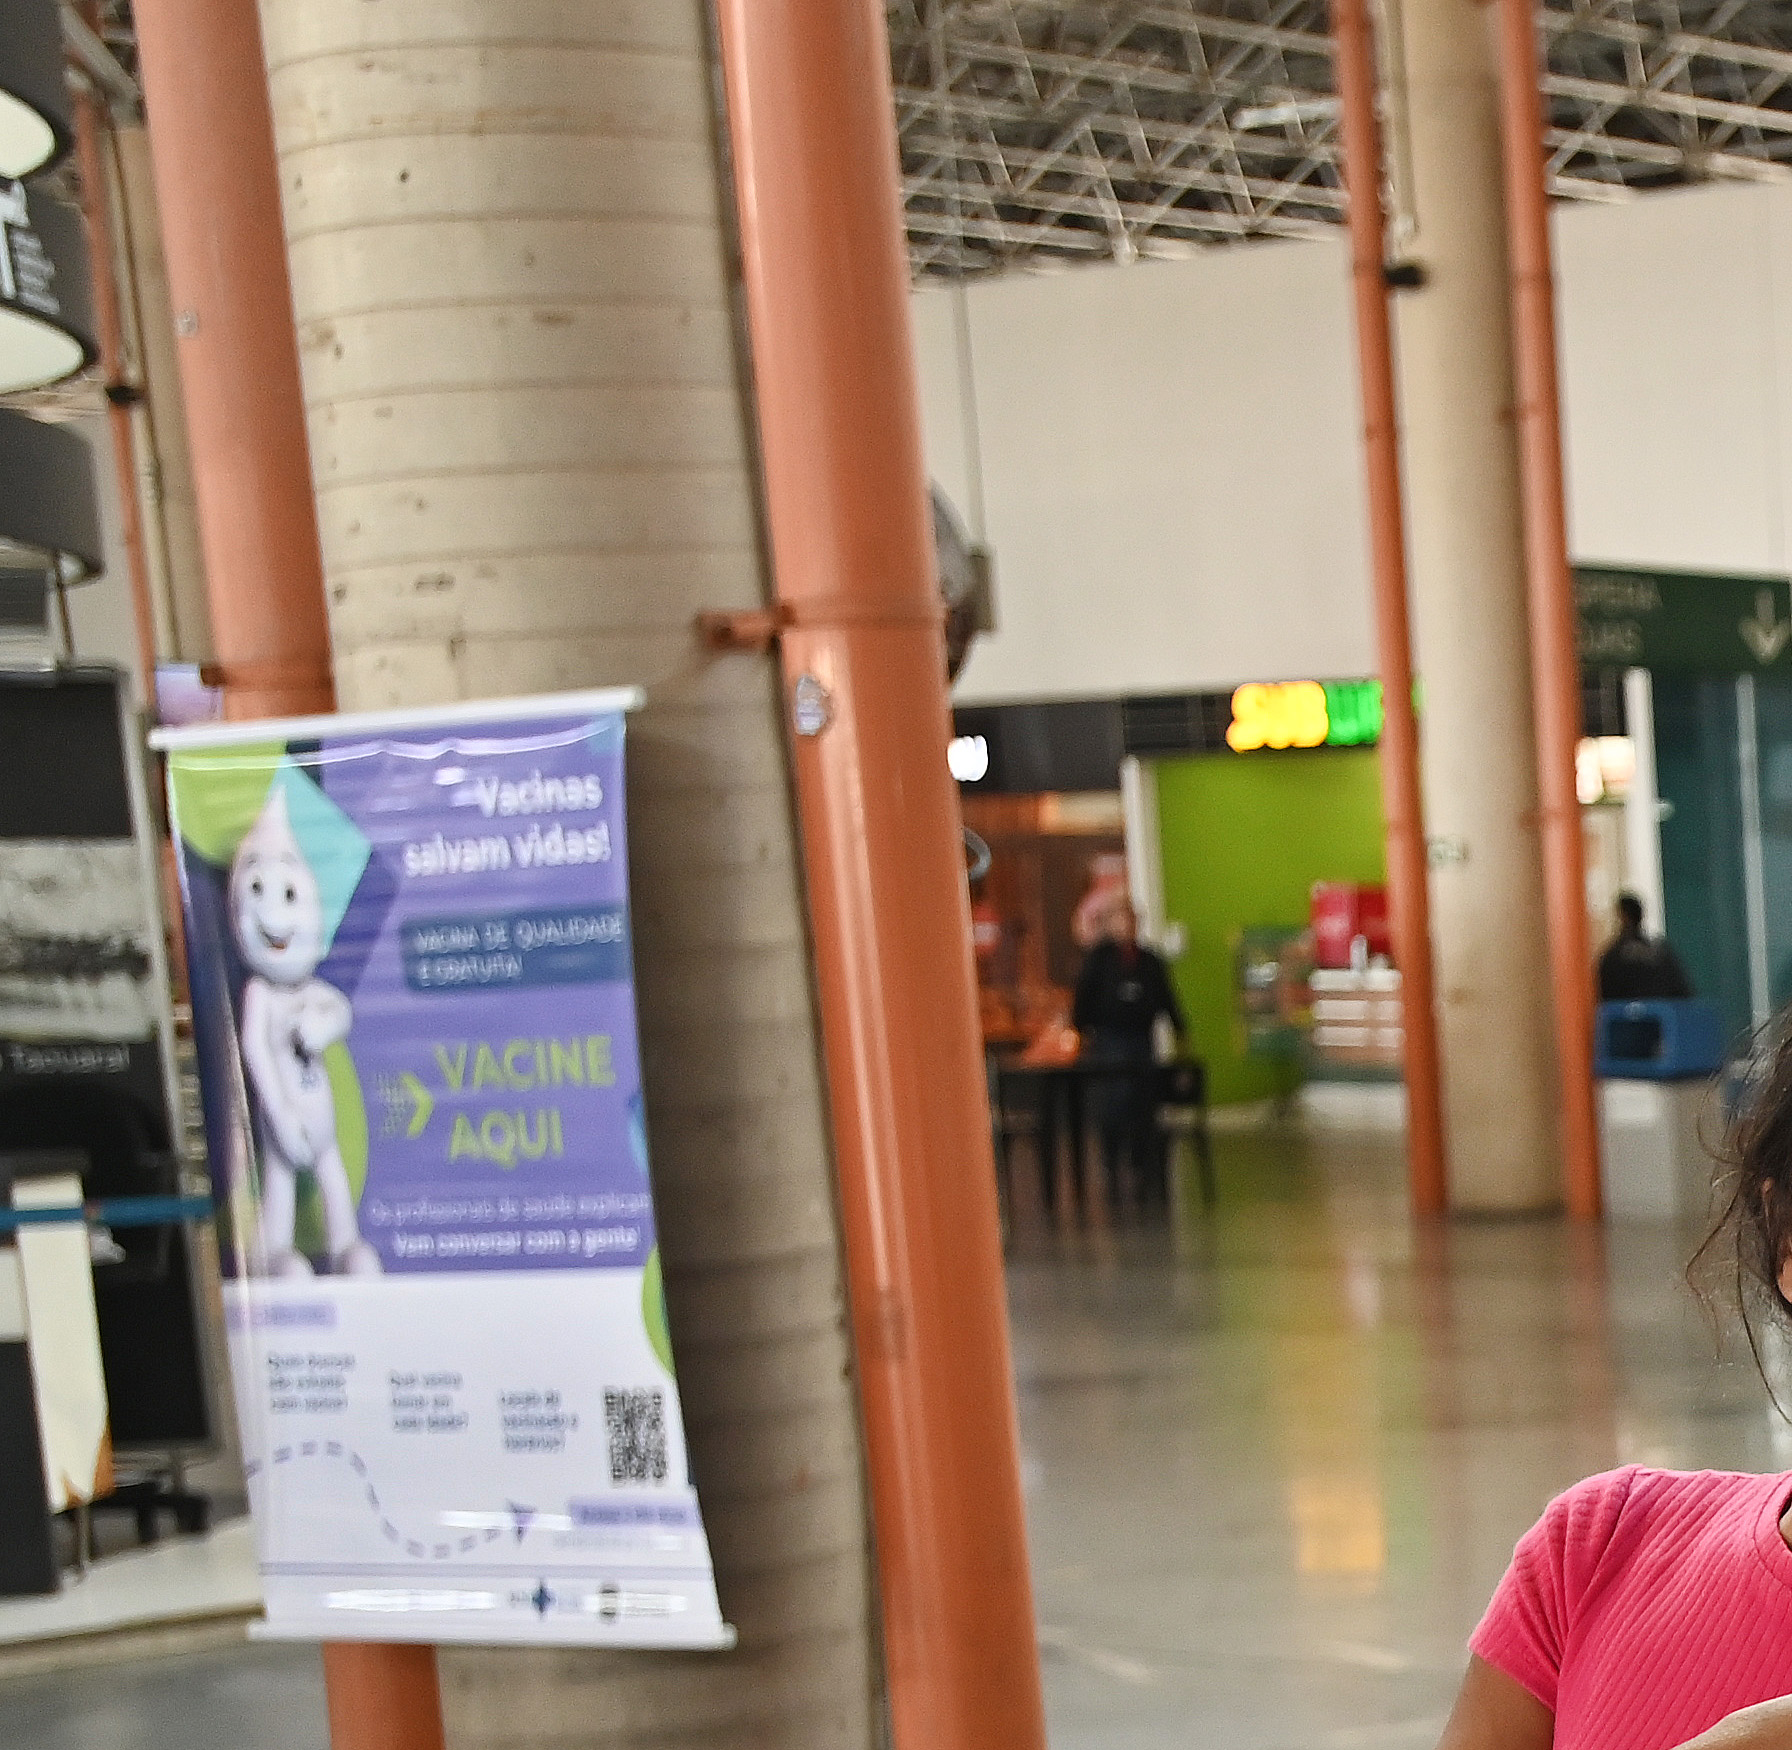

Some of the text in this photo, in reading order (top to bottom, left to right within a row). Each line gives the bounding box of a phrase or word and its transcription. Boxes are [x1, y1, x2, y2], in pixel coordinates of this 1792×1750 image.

[474, 769, 603, 818] Vacinas
[403, 821, 612, 877] salvam vidas!
[434, 1033, 616, 1092] VACINE
[449, 1105, 565, 1171] AQUI
